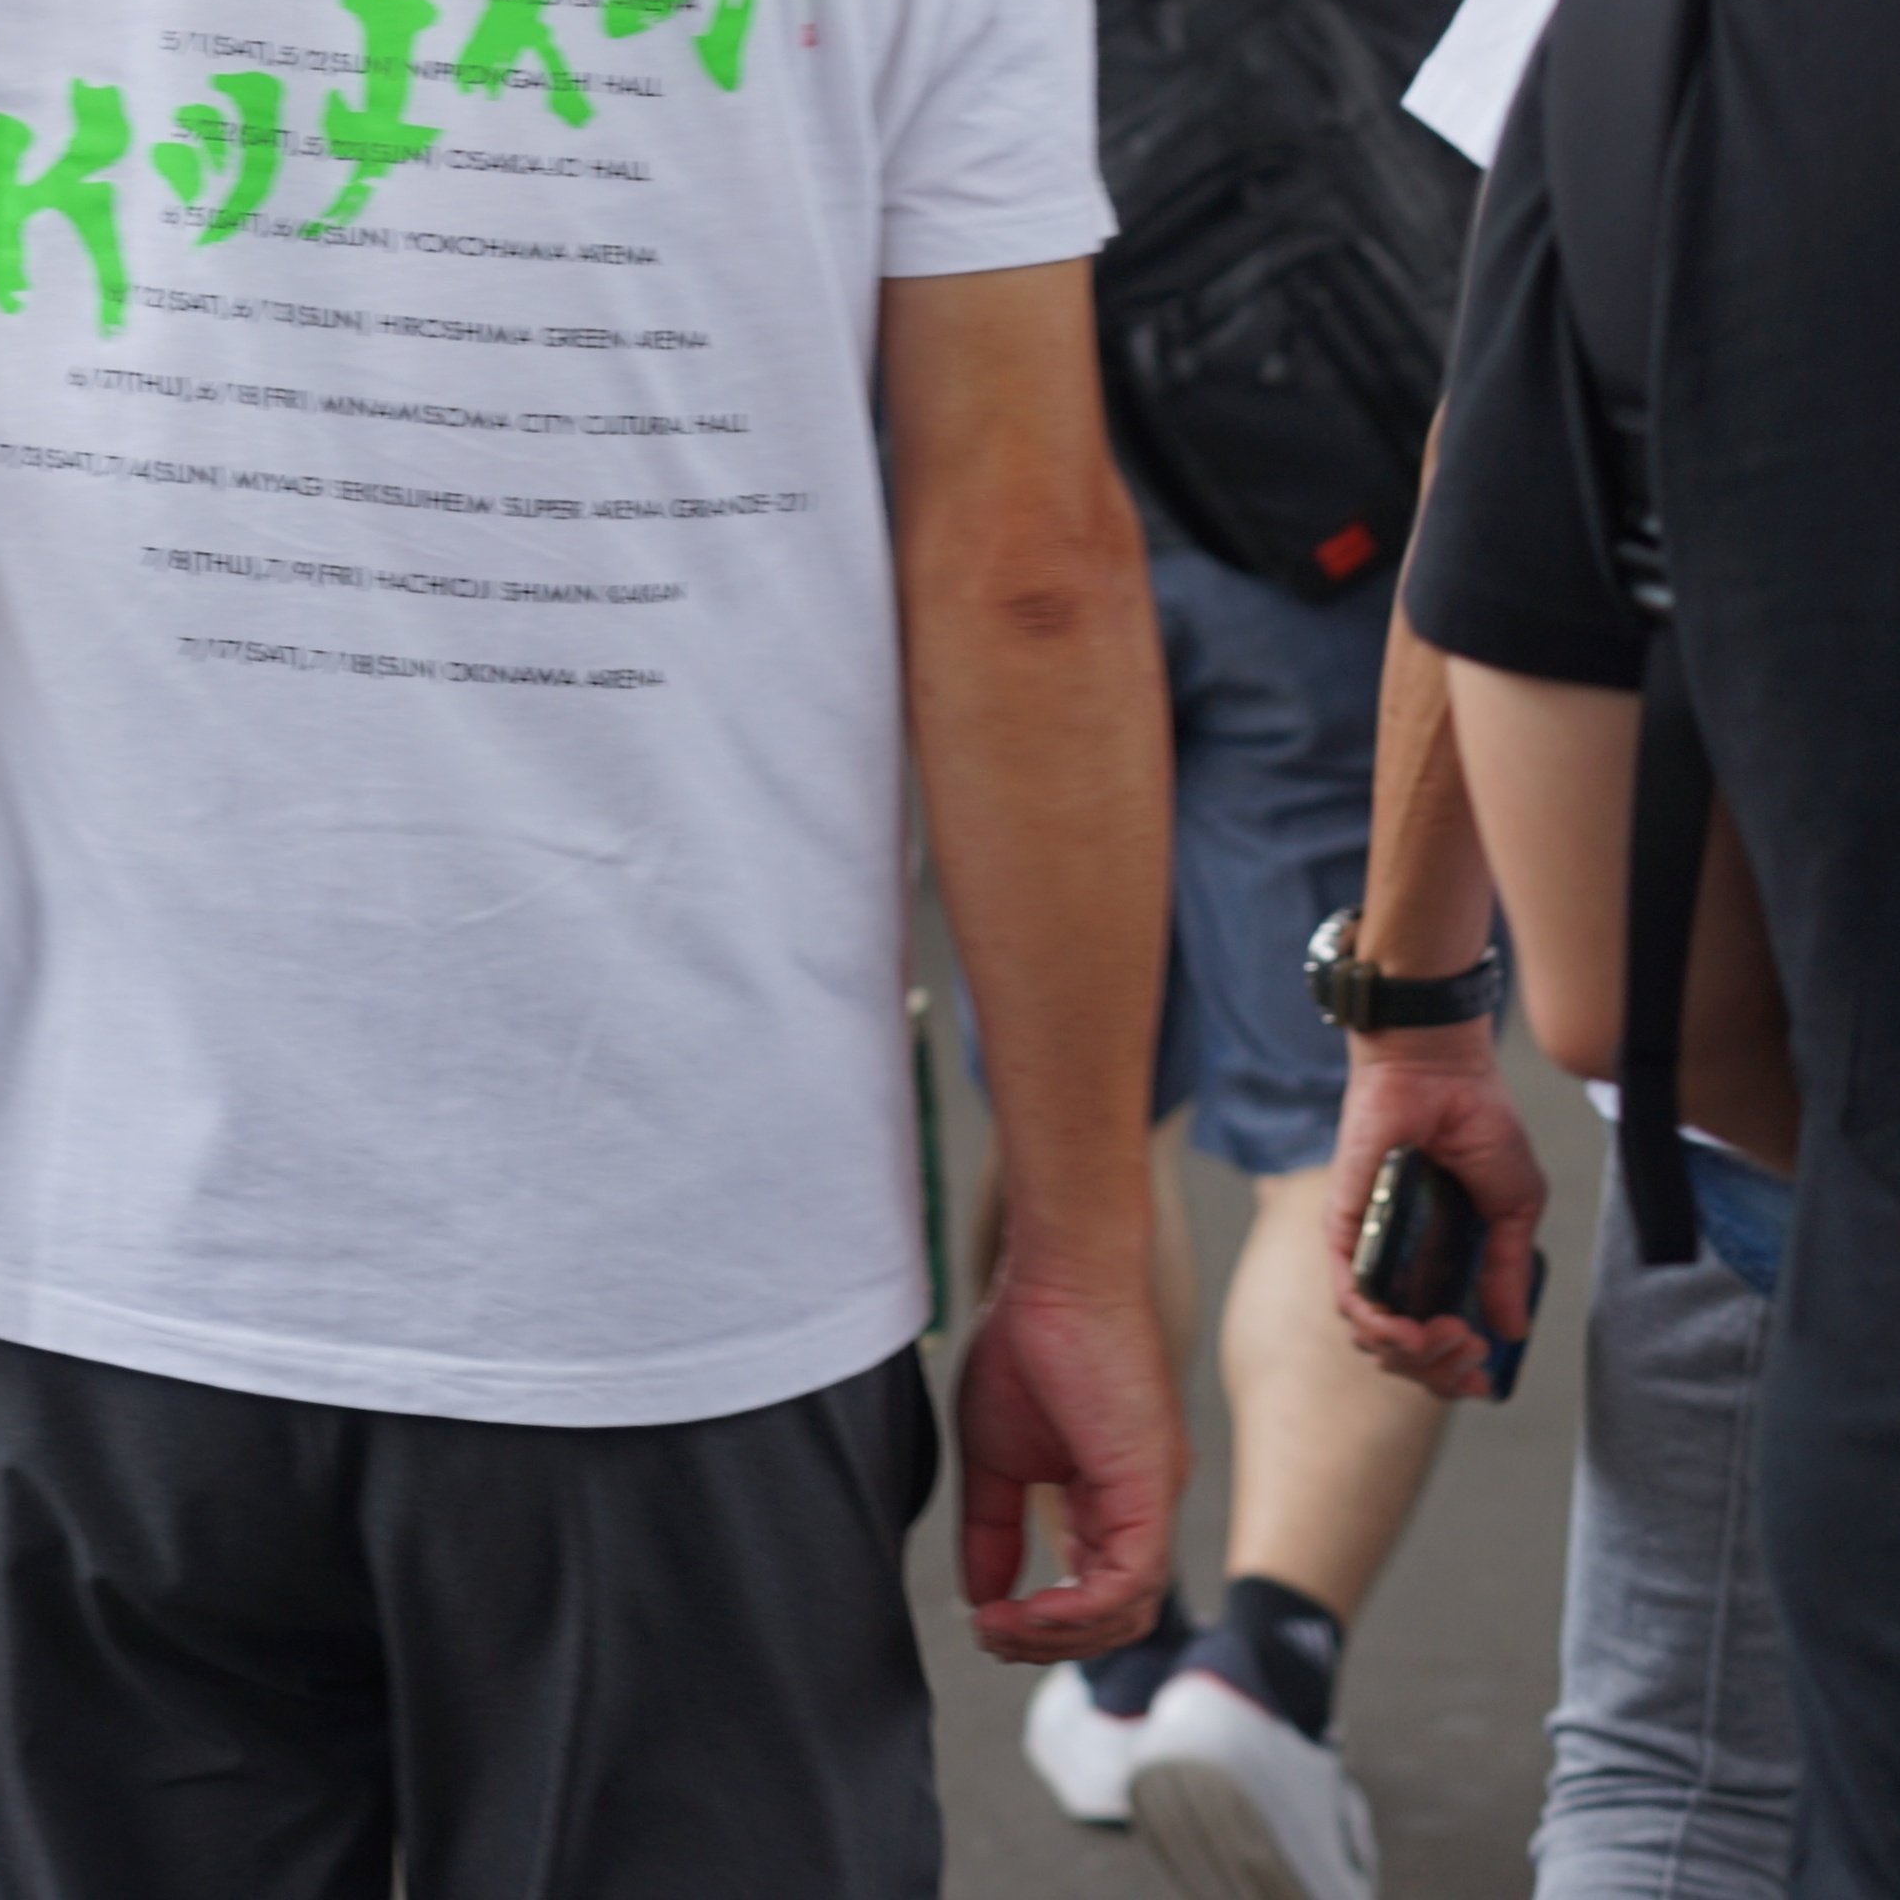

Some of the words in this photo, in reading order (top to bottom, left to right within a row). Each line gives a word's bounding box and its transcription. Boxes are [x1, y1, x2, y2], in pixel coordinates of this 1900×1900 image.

[600, 73, 667, 94] HALL
[588, 158, 654, 179] HALL
[406, 232, 570, 260] YOKOHAMA
[577, 242, 663, 264] ARENA
[378, 313, 533, 344] HIROSHIMA
[541, 323, 627, 347] GREEN
[633, 330, 712, 349] ARENA
[693, 413, 751, 433] HALL
[230, 469, 324, 499] MIYAGI
[502, 494, 584, 518] SUPER
[591, 496, 666, 518] ARENA
[585, 666, 669, 688] ARENA
